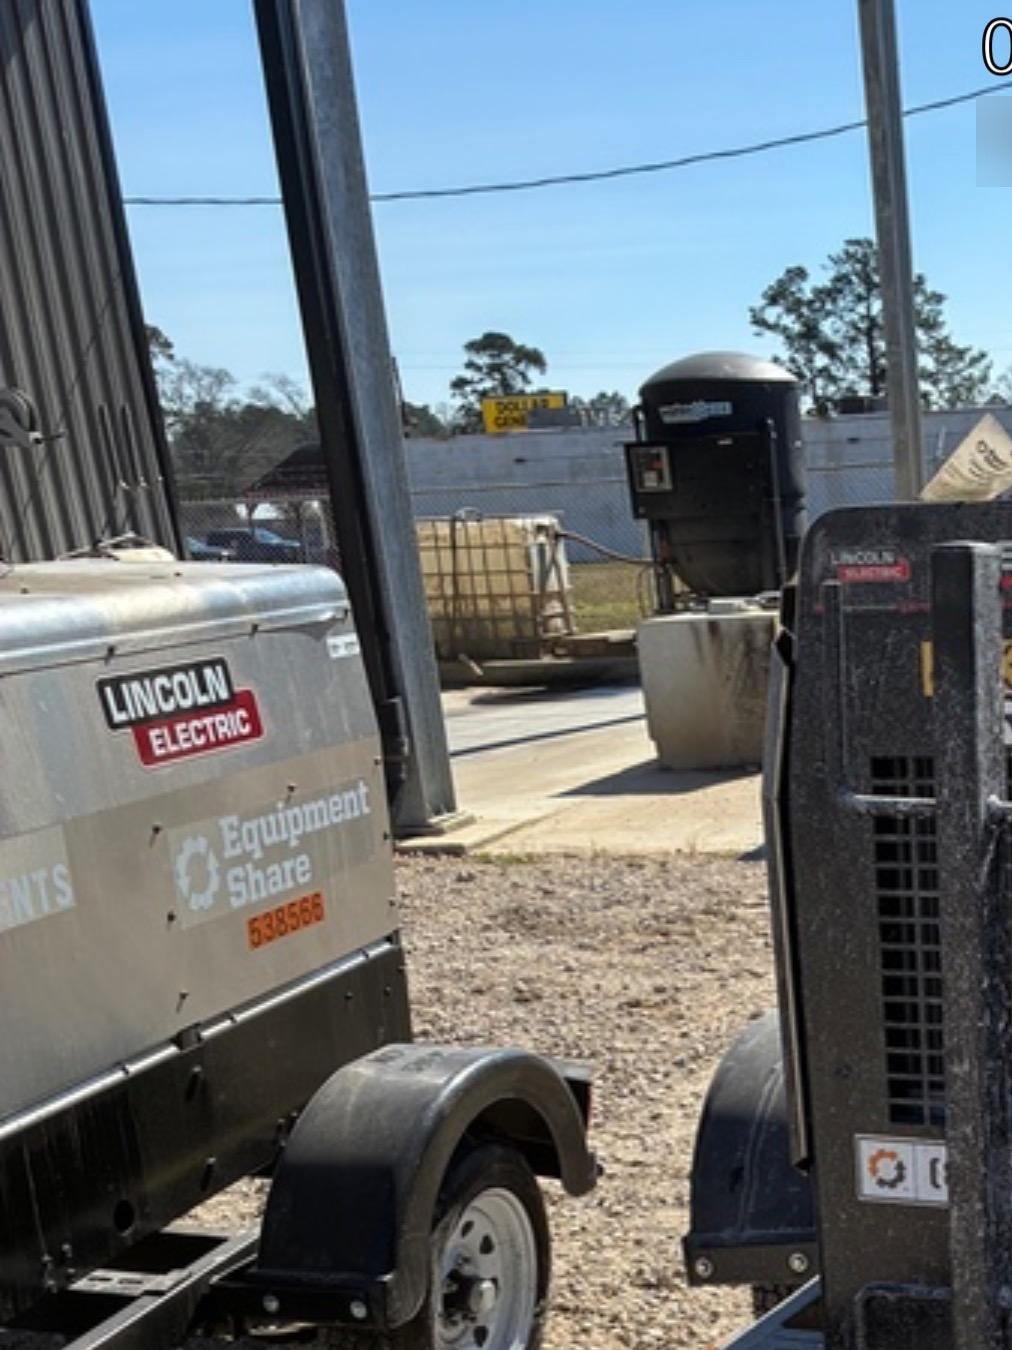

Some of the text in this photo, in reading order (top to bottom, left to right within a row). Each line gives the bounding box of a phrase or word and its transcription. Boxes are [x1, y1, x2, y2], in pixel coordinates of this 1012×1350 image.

[831, 550, 897, 565] LINCOLN
[104, 664, 231, 724] LINCOLN
[149, 708, 252, 756] ELECTRIC
[218, 779, 370, 859] Equipment
[227, 853, 312, 909] Share
